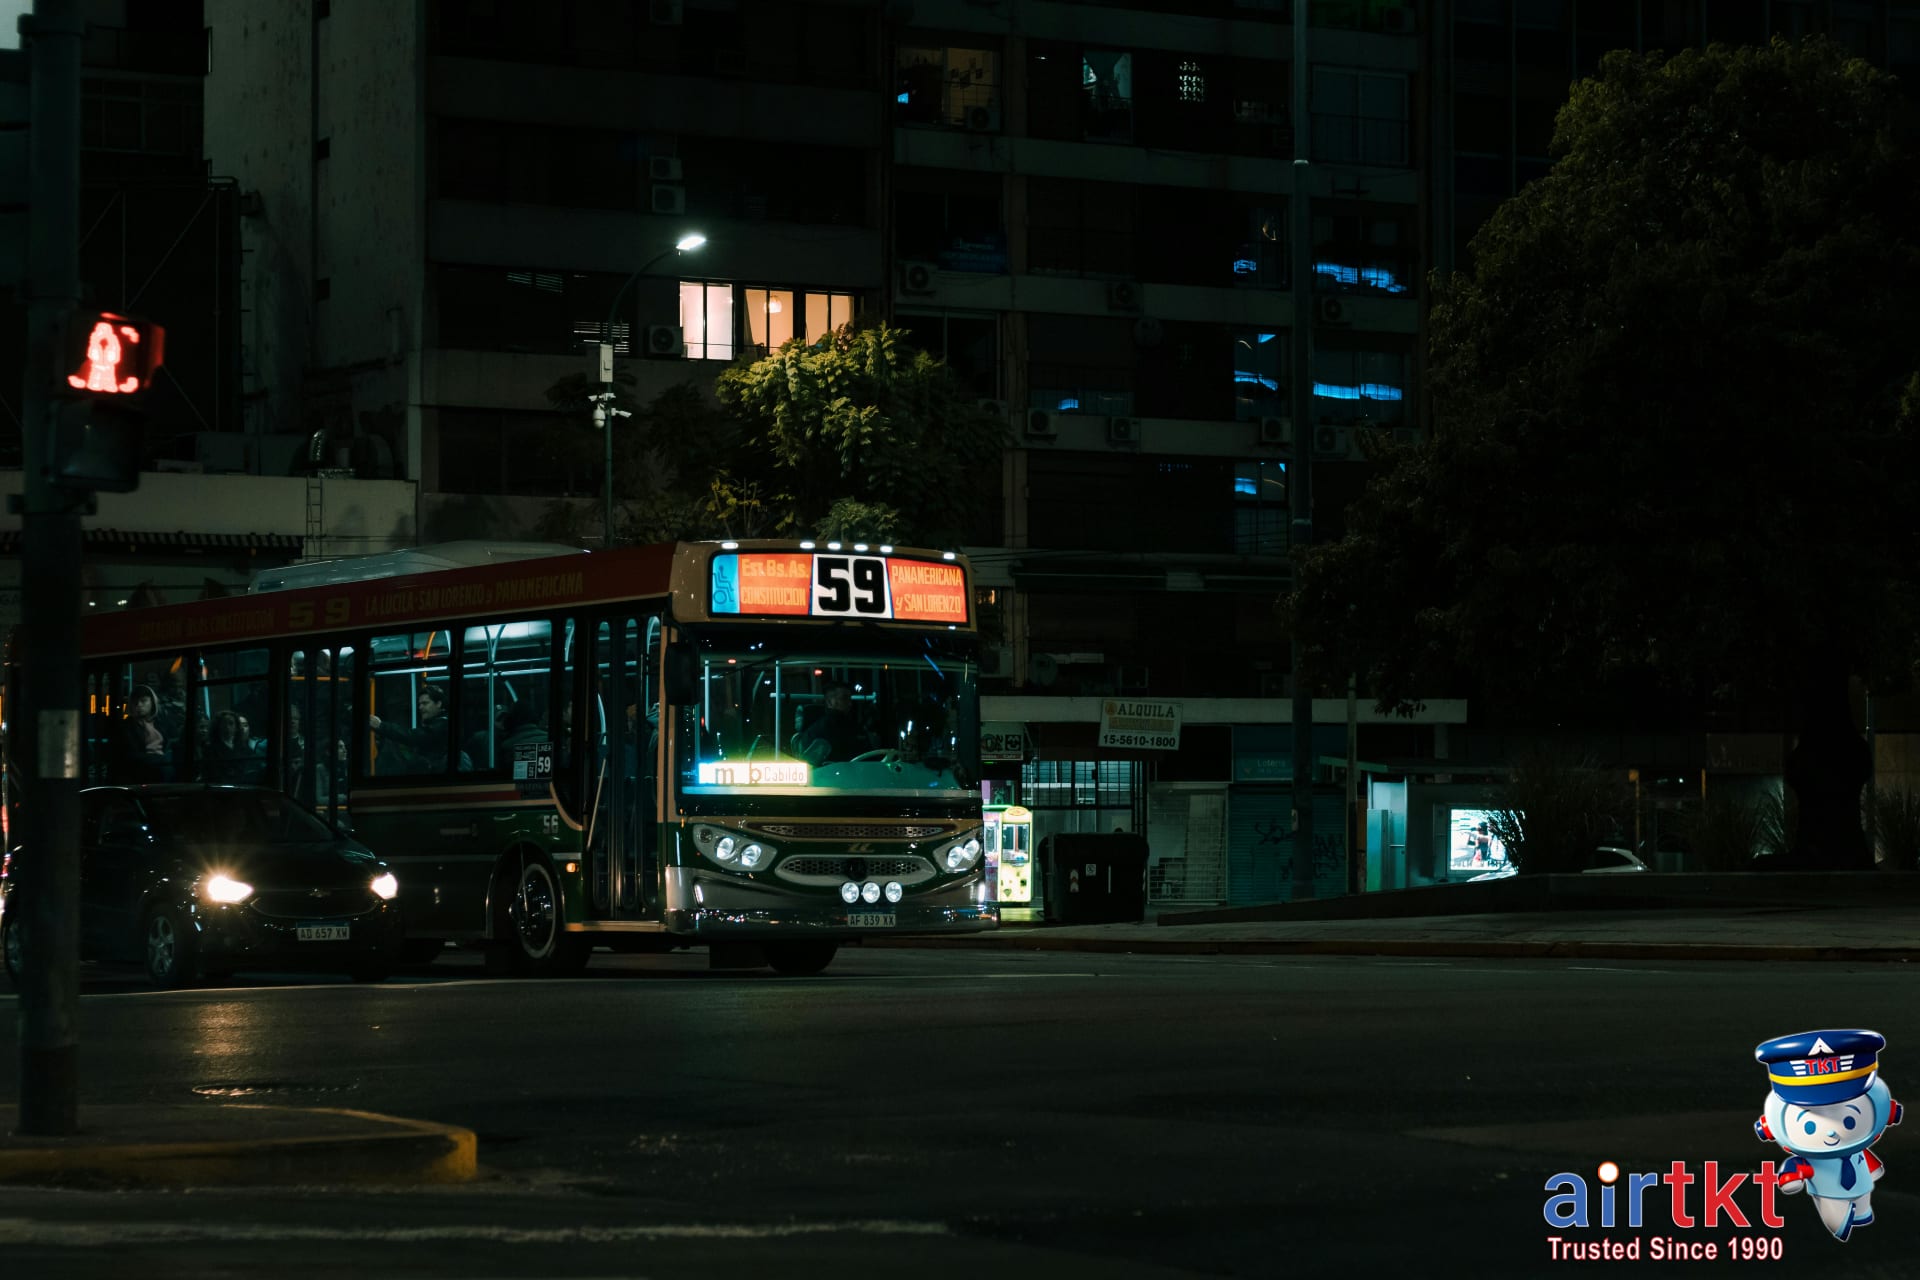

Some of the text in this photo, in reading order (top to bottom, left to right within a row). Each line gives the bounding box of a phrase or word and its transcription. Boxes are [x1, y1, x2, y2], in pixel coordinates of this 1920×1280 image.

[892, 565, 962, 586] PANAMERICANA
[496, 572, 584, 603] PANAMERICANA
[817, 557, 885, 613] 59
[287, 597, 351, 627] 59
[1117, 703, 1175, 718] ALQUILA
[1103, 734, 1176, 747] 15-5610-1800
[537, 756, 551, 774] 59
[764, 766, 804, 782] Cabildo
[863, 915, 880, 926] 839
[315, 928, 332, 939] 657
